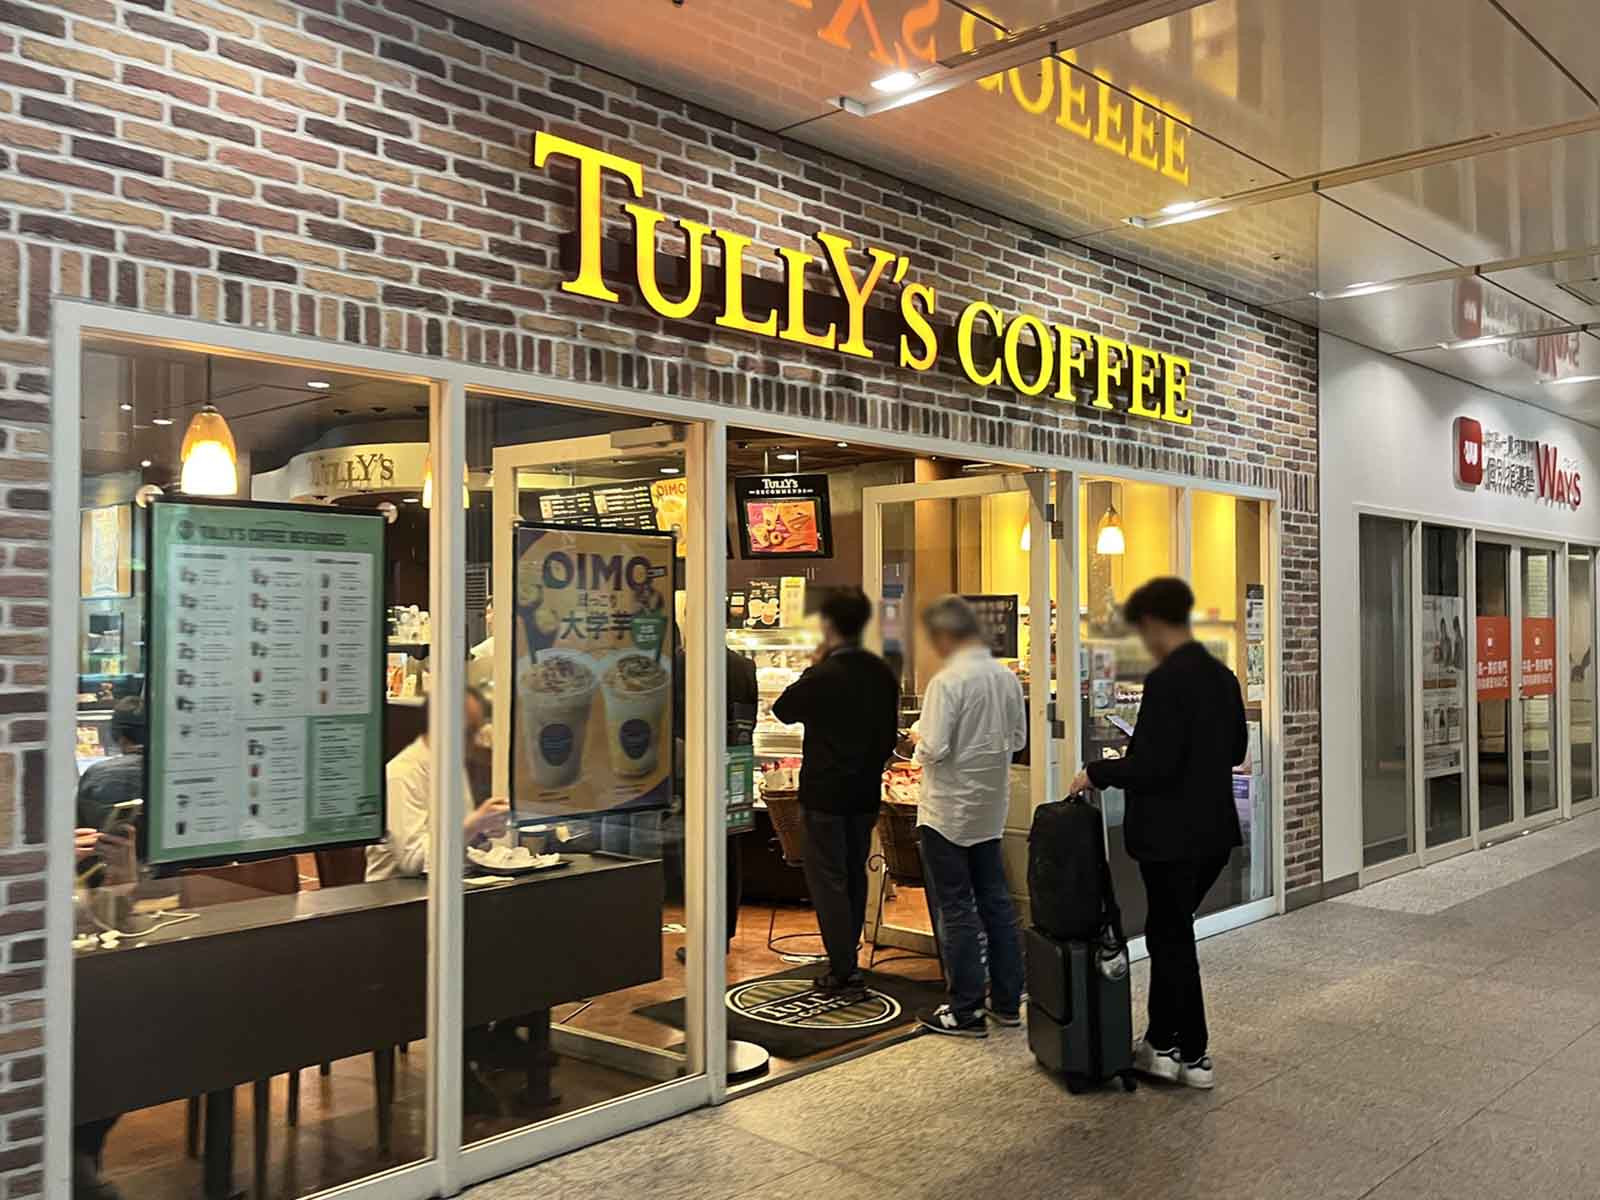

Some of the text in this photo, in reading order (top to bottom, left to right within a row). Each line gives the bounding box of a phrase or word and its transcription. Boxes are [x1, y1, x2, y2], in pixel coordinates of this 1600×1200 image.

[533, 130, 1194, 425] TULLY'S COFFEE
[1535, 440, 1582, 506] WAYS
[543, 551, 651, 592] OIMO
